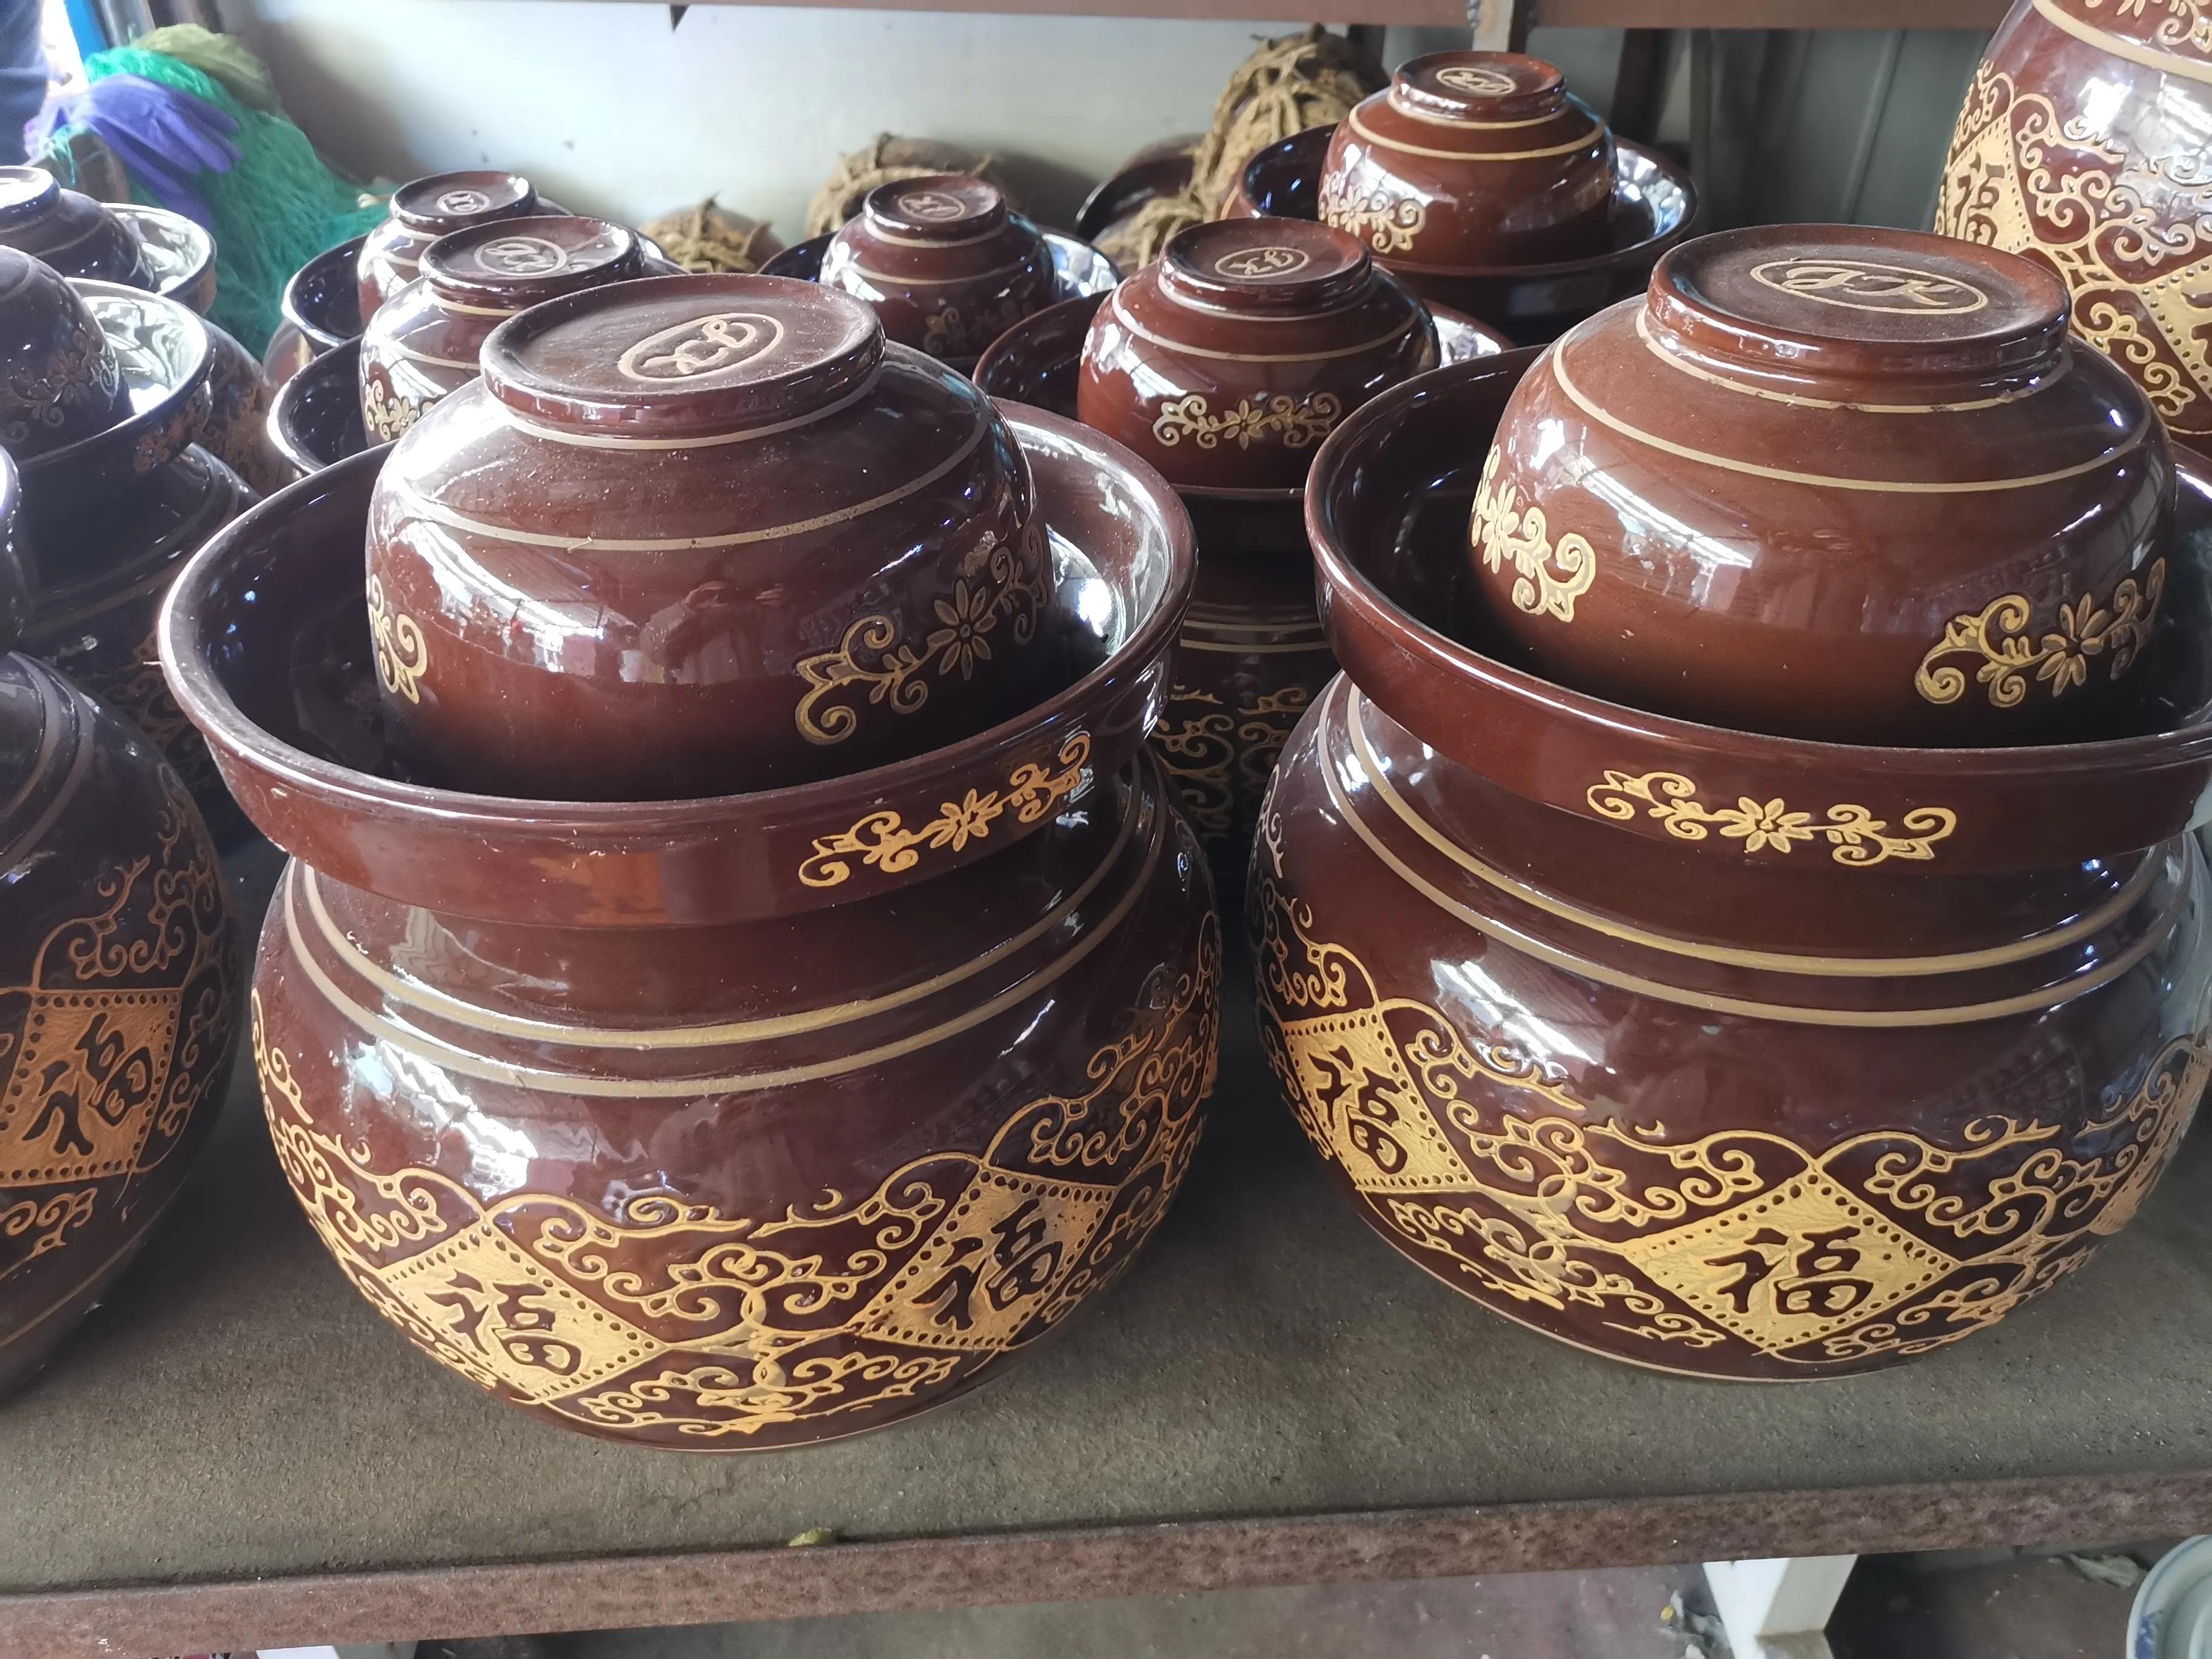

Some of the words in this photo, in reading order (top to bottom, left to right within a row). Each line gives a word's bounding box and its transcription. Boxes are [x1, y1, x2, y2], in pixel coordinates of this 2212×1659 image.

[22, 1012, 153, 1156] 福
[1307, 1044, 1409, 1175] 福
[424, 1269, 582, 1376] 福
[910, 1198, 1065, 1331] 福
[1703, 1225, 1874, 1318] 福
